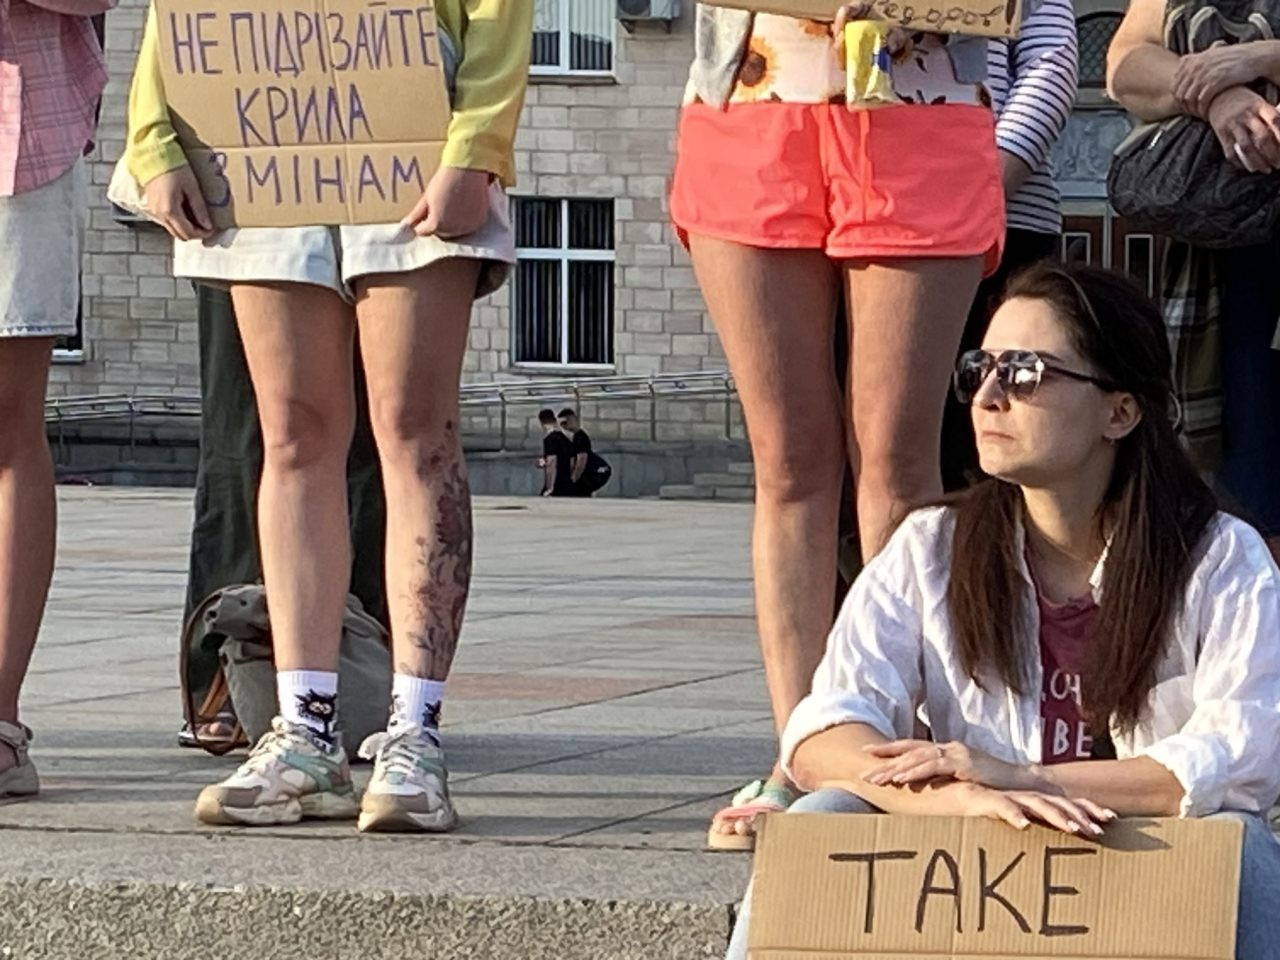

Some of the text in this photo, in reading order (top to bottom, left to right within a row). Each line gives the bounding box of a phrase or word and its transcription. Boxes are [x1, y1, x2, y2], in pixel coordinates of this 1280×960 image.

[170, 1, 440, 78] НЕ ПІДРІЗАЙТЕ
[234, 83, 374, 147] КРИЛА
[206, 151, 426, 208] ЗМІНАМ
[828, 846, 1099, 937] ТАКЕ
